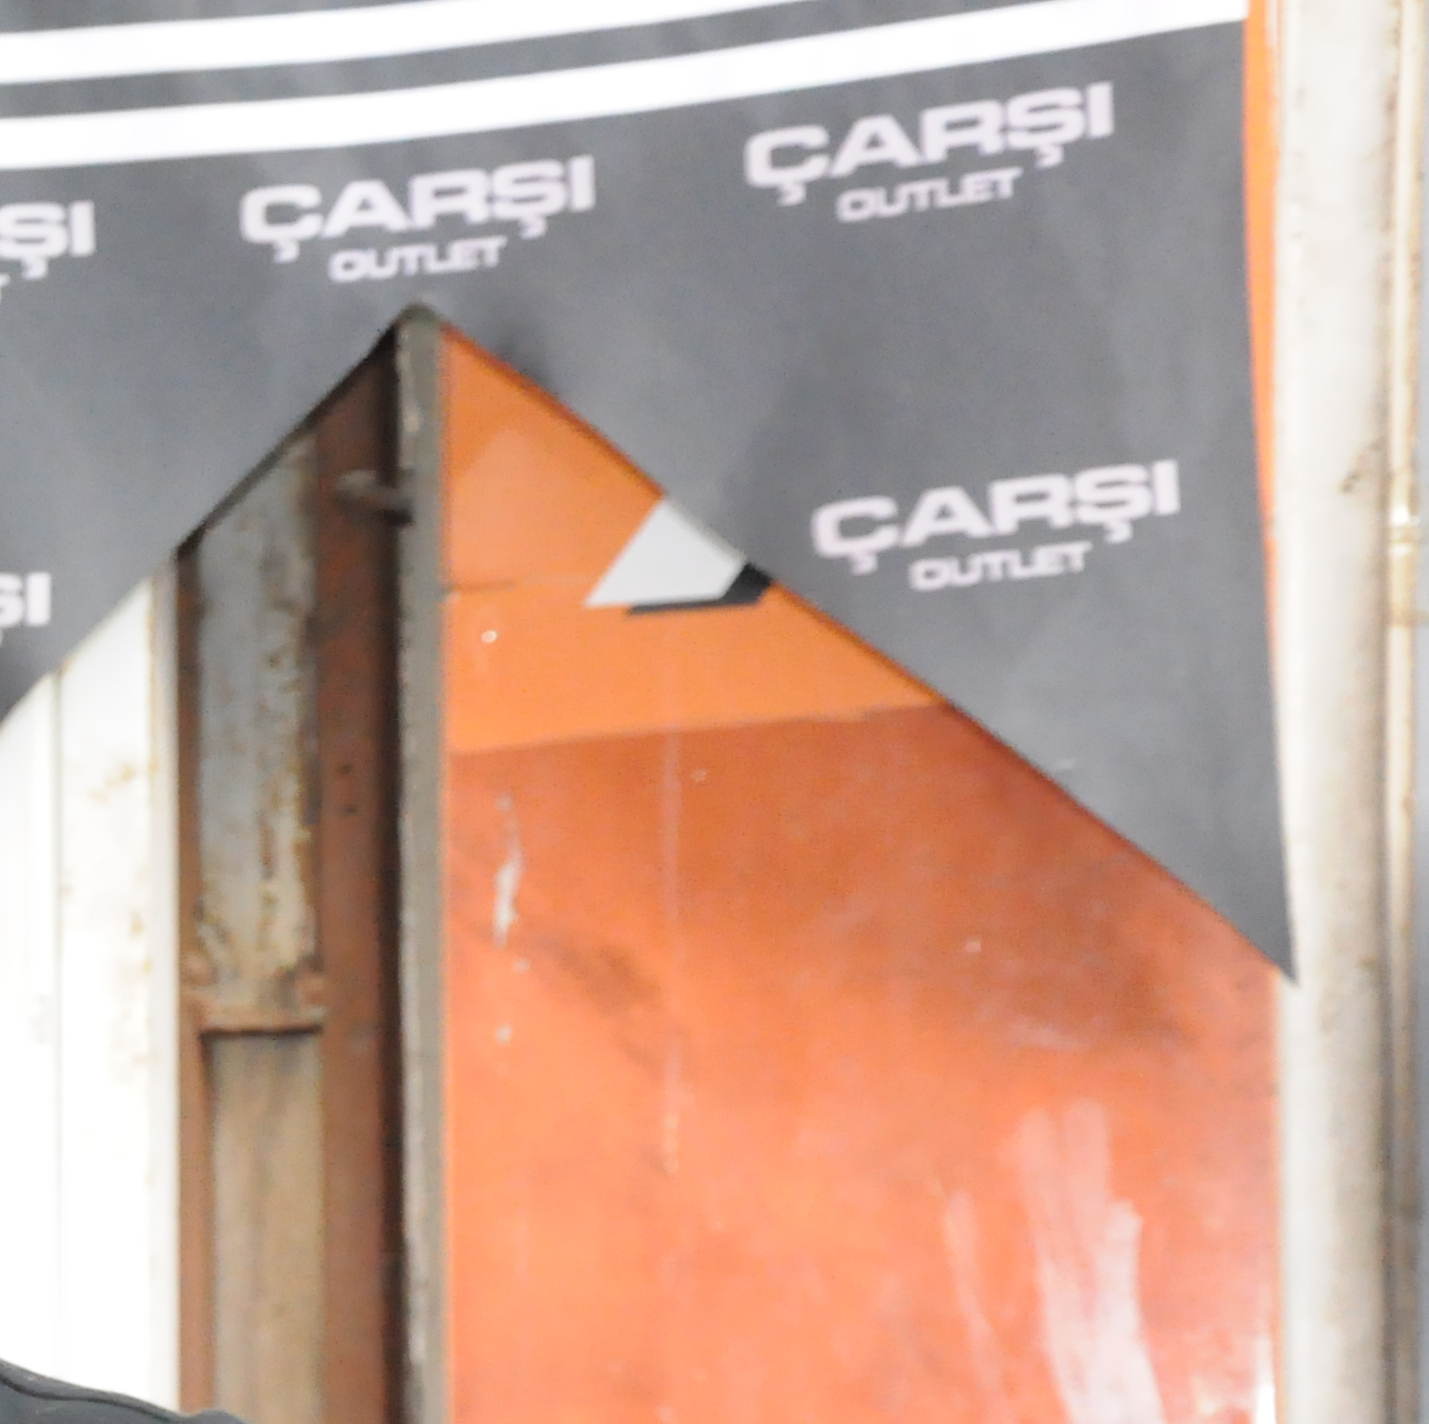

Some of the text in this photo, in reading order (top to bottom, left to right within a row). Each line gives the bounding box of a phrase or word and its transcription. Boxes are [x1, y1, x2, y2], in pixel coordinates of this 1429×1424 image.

[745, 82, 1114, 206] ÇARŞI
[241, 155, 595, 262] ÇARŞI
[836, 165, 1023, 223] OUTLET
[328, 235, 507, 284] OUTLET
[813, 458, 1181, 575] ÇARŞI
[910, 539, 1093, 592] OUTLET
